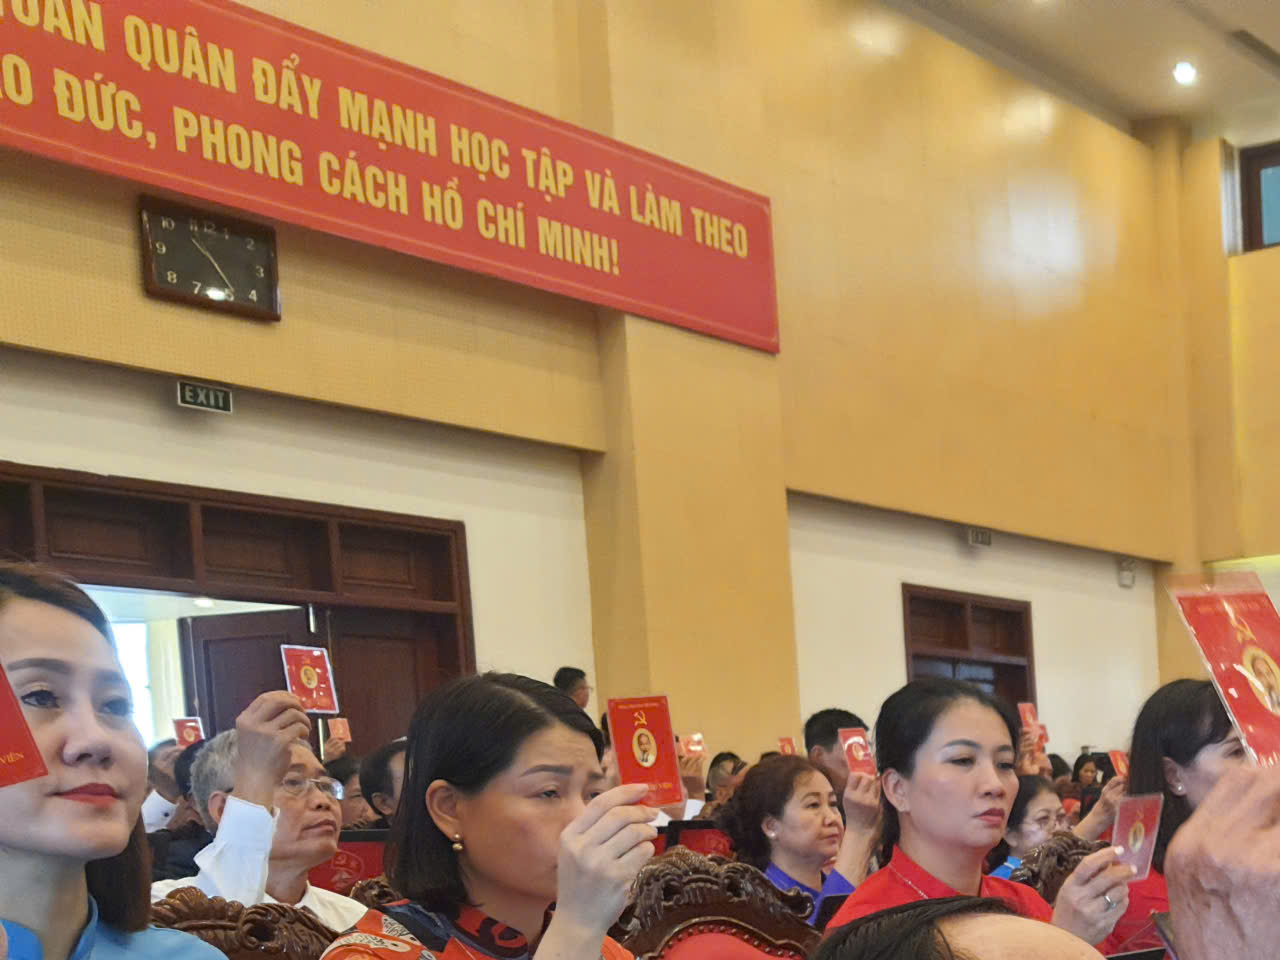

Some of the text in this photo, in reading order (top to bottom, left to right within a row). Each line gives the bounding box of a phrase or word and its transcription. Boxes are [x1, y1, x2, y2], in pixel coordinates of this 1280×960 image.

[124, 15, 236, 93] QUÂN
[252, 53, 321, 119] ĐẨY
[338, 87, 437, 156] MẠNH
[450, 124, 510, 181] HỌC
[522, 147, 573, 202] TẬP
[585, 169, 620, 215] VÀ
[630, 184, 682, 236] LÀM
[691, 208, 747, 258] THEO
[0, 54, 619, 275] O ĐỨC, PHONG CÁCH HỒ CHÍ MINH!
[156, 241, 166, 254] 9
[167, 271, 177, 284] 8
[192, 281, 201, 294] 7
[249, 289, 257, 302] 4
[185, 385, 224, 408] EXIT
